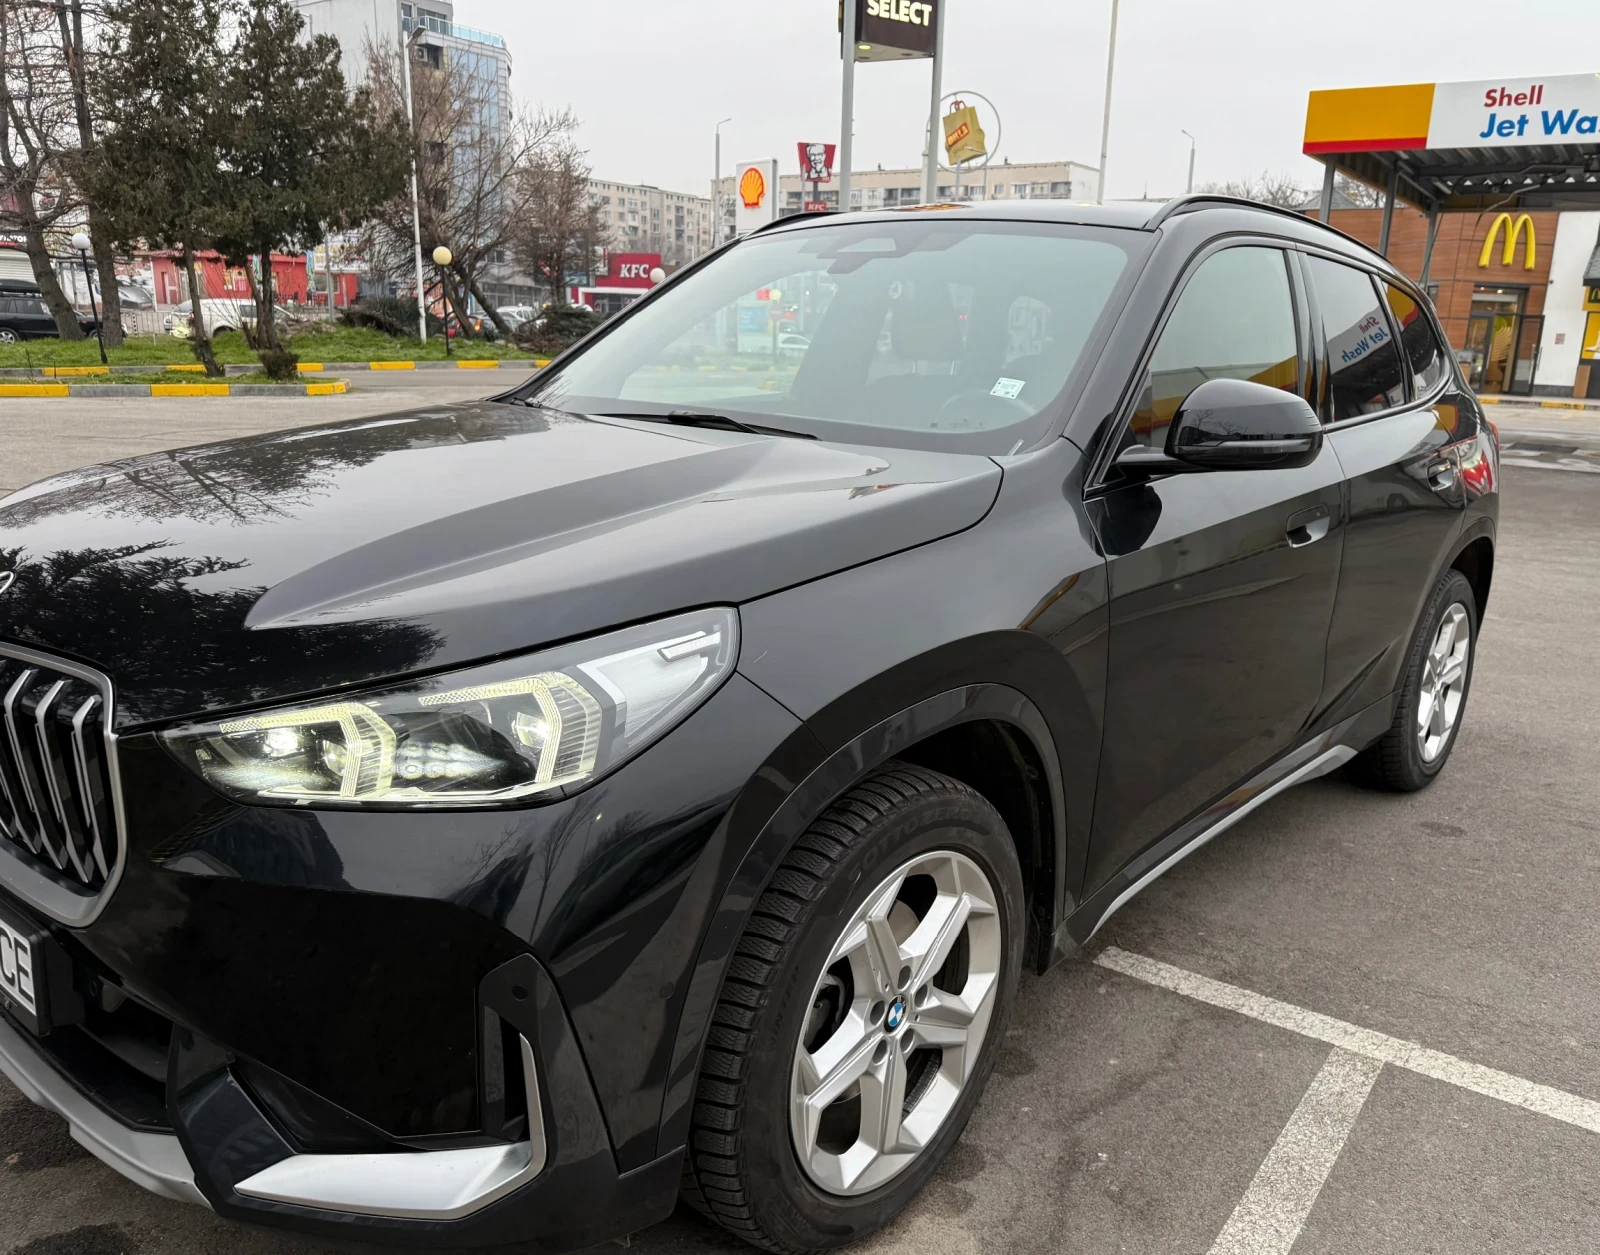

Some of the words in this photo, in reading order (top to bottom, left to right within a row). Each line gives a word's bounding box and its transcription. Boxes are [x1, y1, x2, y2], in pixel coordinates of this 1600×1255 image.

[867, 0, 932, 26] SELECT
[1484, 84, 1543, 107] Shell
[1479, 113, 1529, 138] Jet
[1541, 109, 1600, 135] Wa
[620, 264, 649, 278] KFC
[0, 926, 34, 1006] CE
